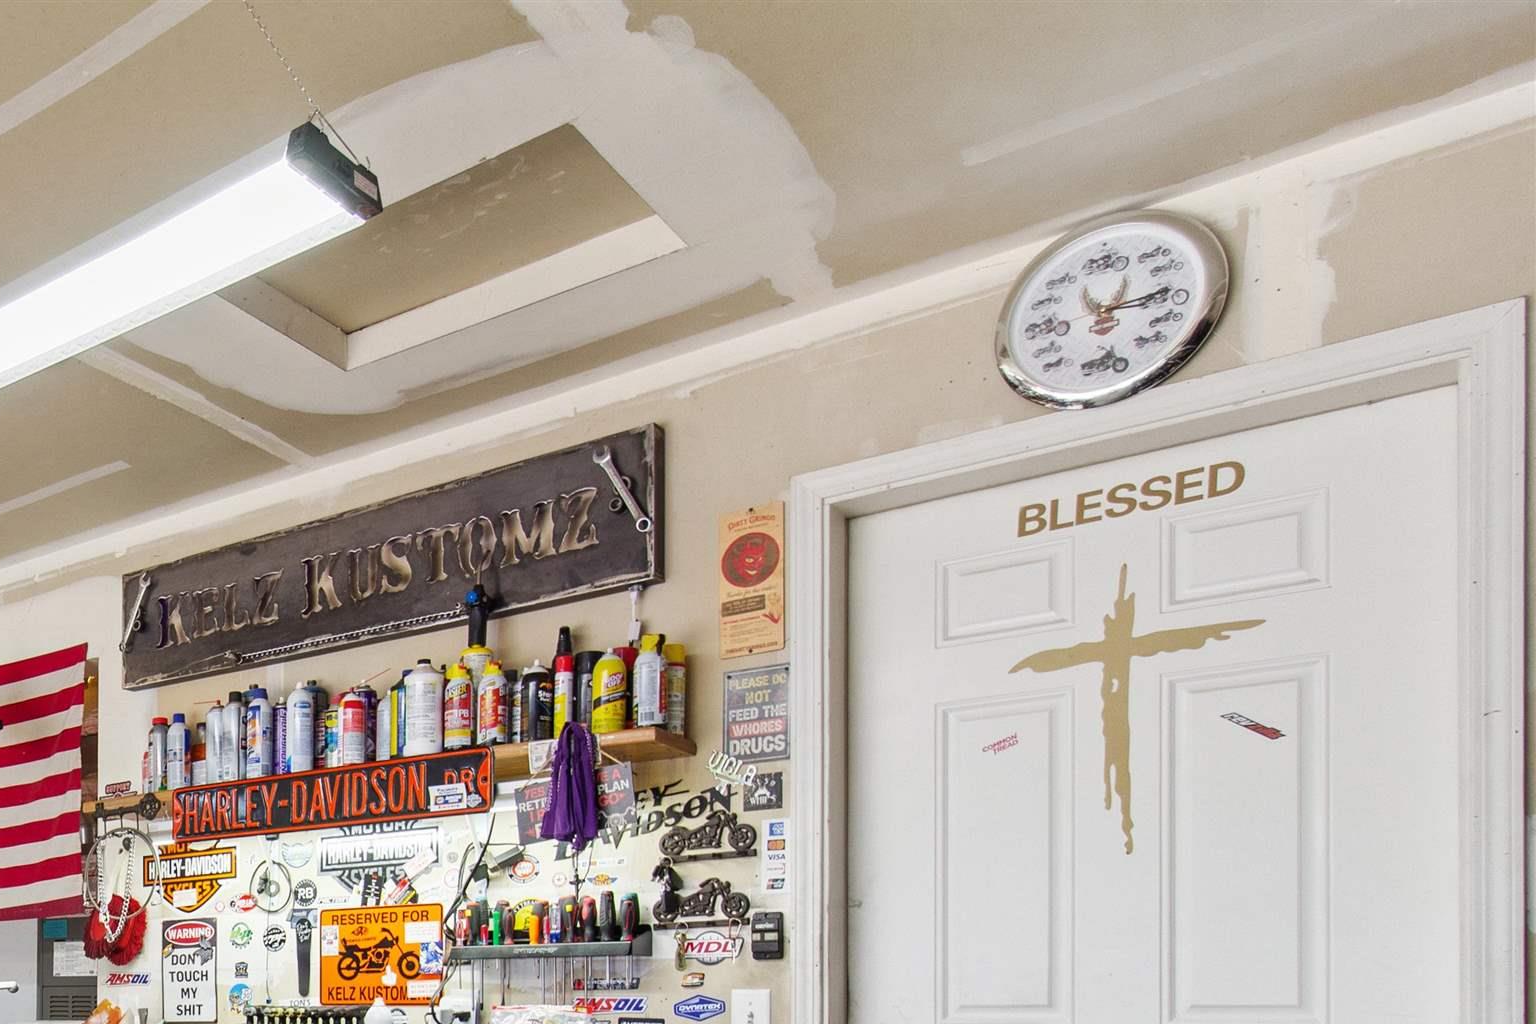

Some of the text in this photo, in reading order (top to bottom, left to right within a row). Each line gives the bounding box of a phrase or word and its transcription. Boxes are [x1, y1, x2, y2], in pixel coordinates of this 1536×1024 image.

[1017, 461, 1246, 537] BLESSED
[156, 487, 599, 650] KELZ KUSTOMZ
[728, 674, 769, 691] PLEASE
[745, 689, 770, 704] NOT
[728, 703, 787, 722] FEED THE
[731, 720, 783, 738] WHORES
[729, 734, 786, 757] DRUGS
[597, 779, 630, 796] PLAN
[183, 763, 428, 836] HARLEY-DAVIDSON
[768, 853, 786, 861] VISA
[148, 854, 232, 880] HARLEY-DAVIDSON
[297, 887, 313, 900] RB
[331, 910, 429, 926] RESERVED FOR
[168, 927, 212, 939] WARNING
[106, 973, 150, 985] AMSOIL
[169, 969, 209, 982] TOUCH
[181, 987, 198, 999] MY
[327, 986, 356, 1001] KELZ
[176, 1004, 203, 1016] SHIT
